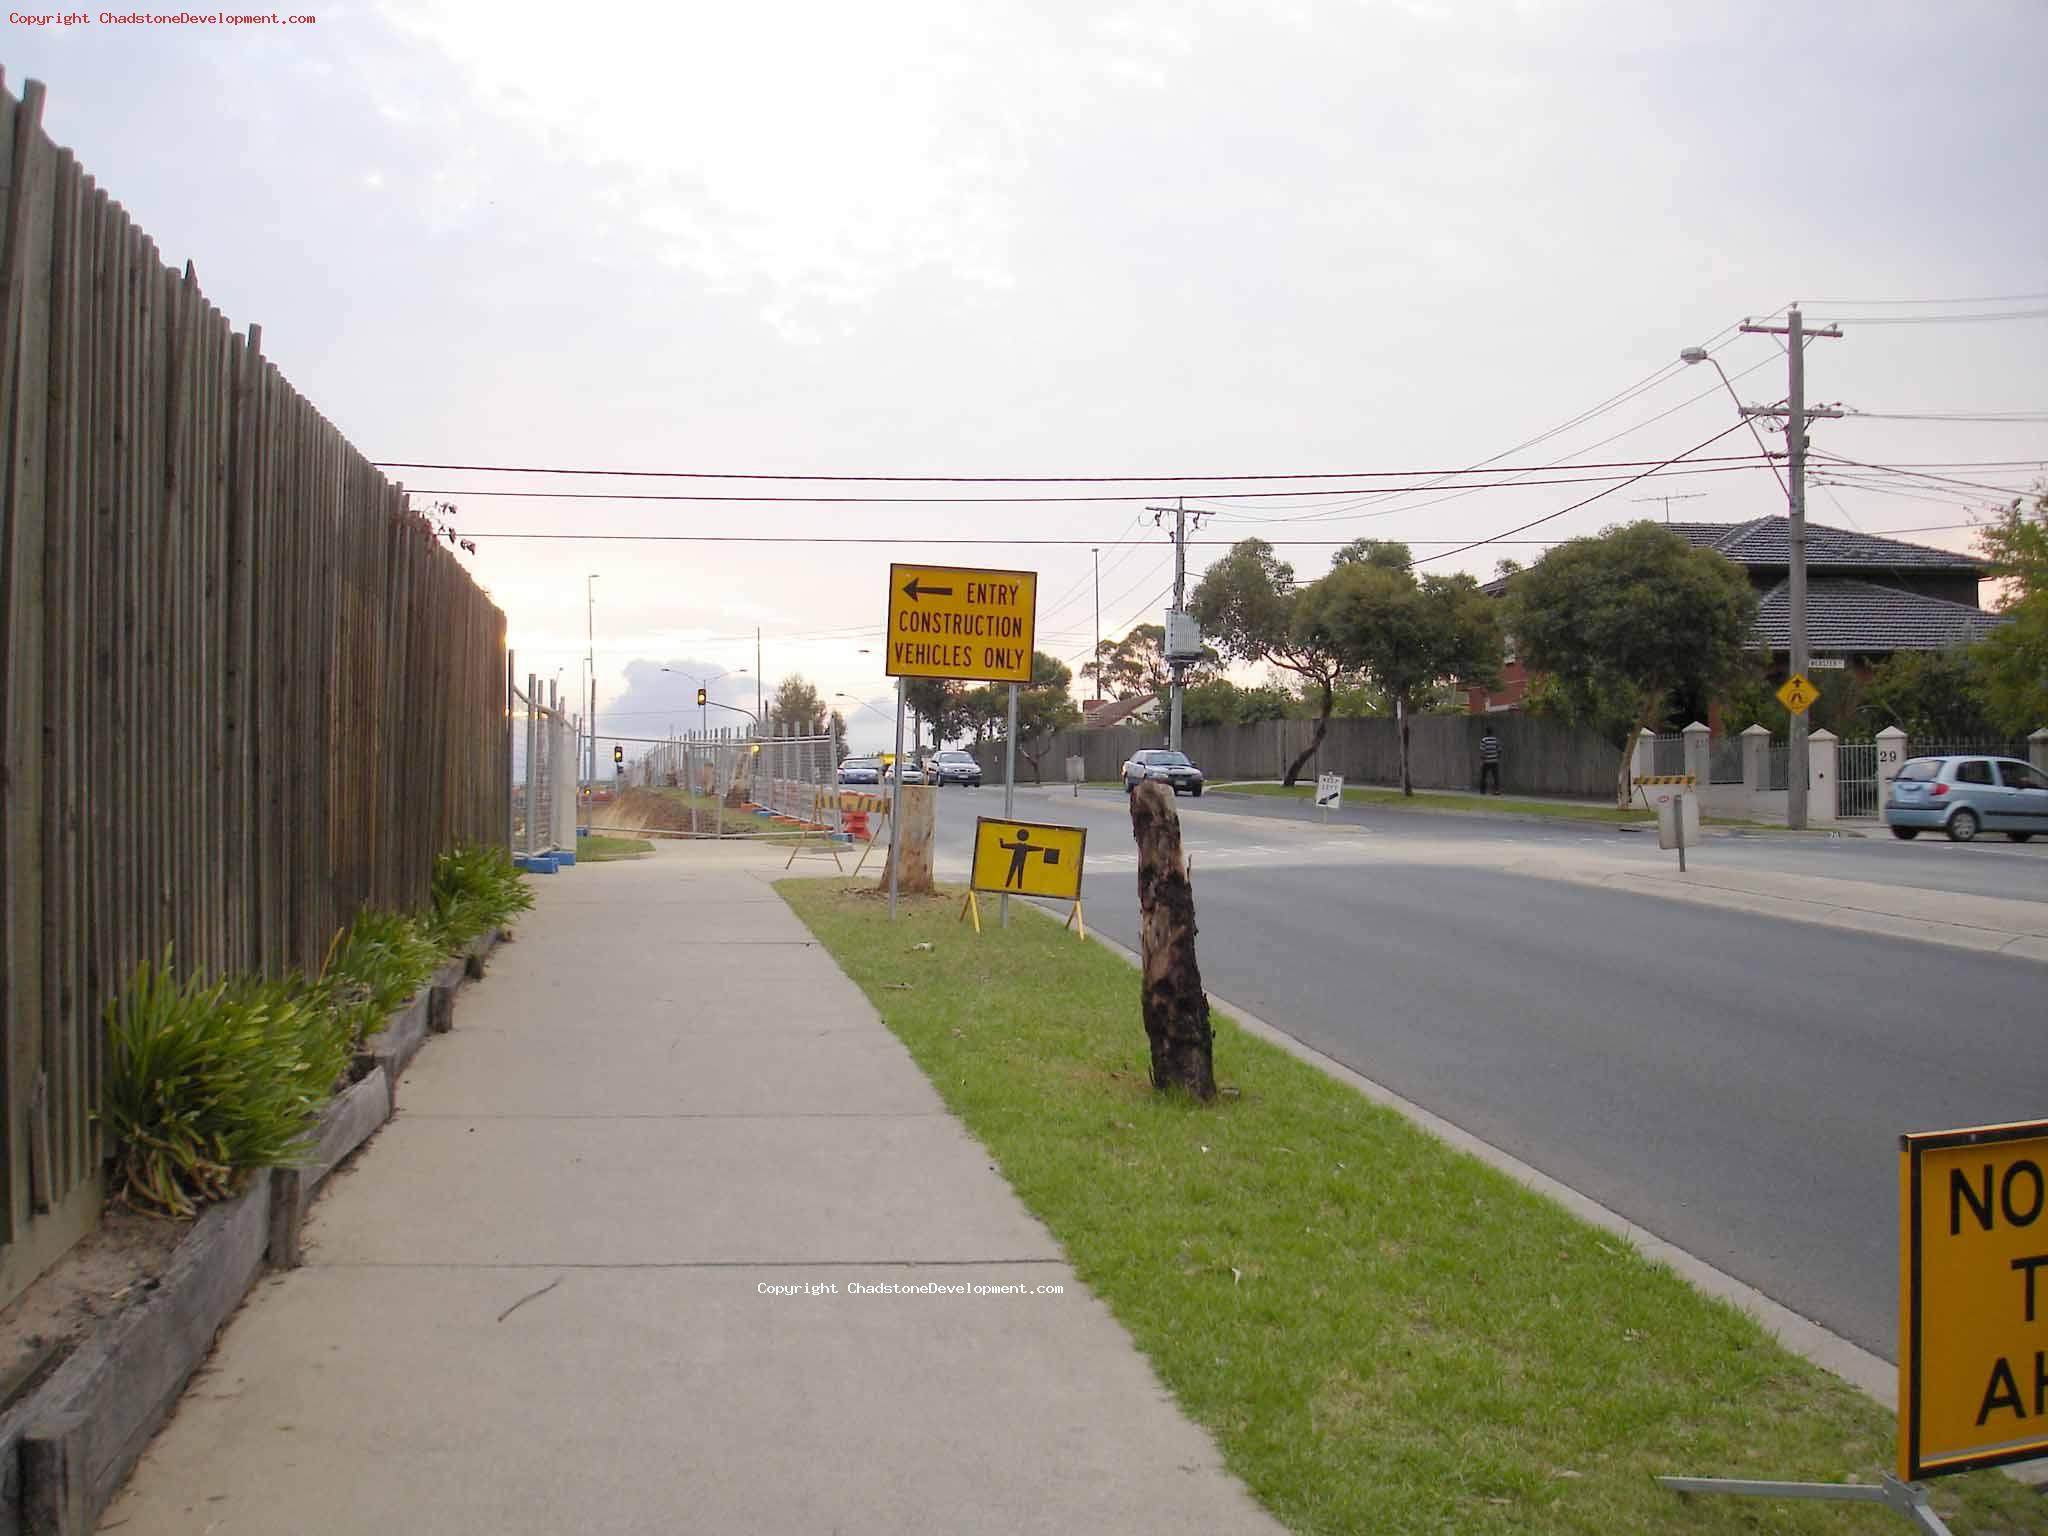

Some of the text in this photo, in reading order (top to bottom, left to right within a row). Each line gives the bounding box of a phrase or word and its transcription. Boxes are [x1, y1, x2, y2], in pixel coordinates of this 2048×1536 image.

[967, 582, 1019, 606] ENTRY
[899, 610, 1022, 638] CONSTRUCTION
[895, 642, 1024, 670] VEHICLES ONLY
[1879, 751, 1897, 762] 29
[1950, 1160, 2044, 1236] NO
